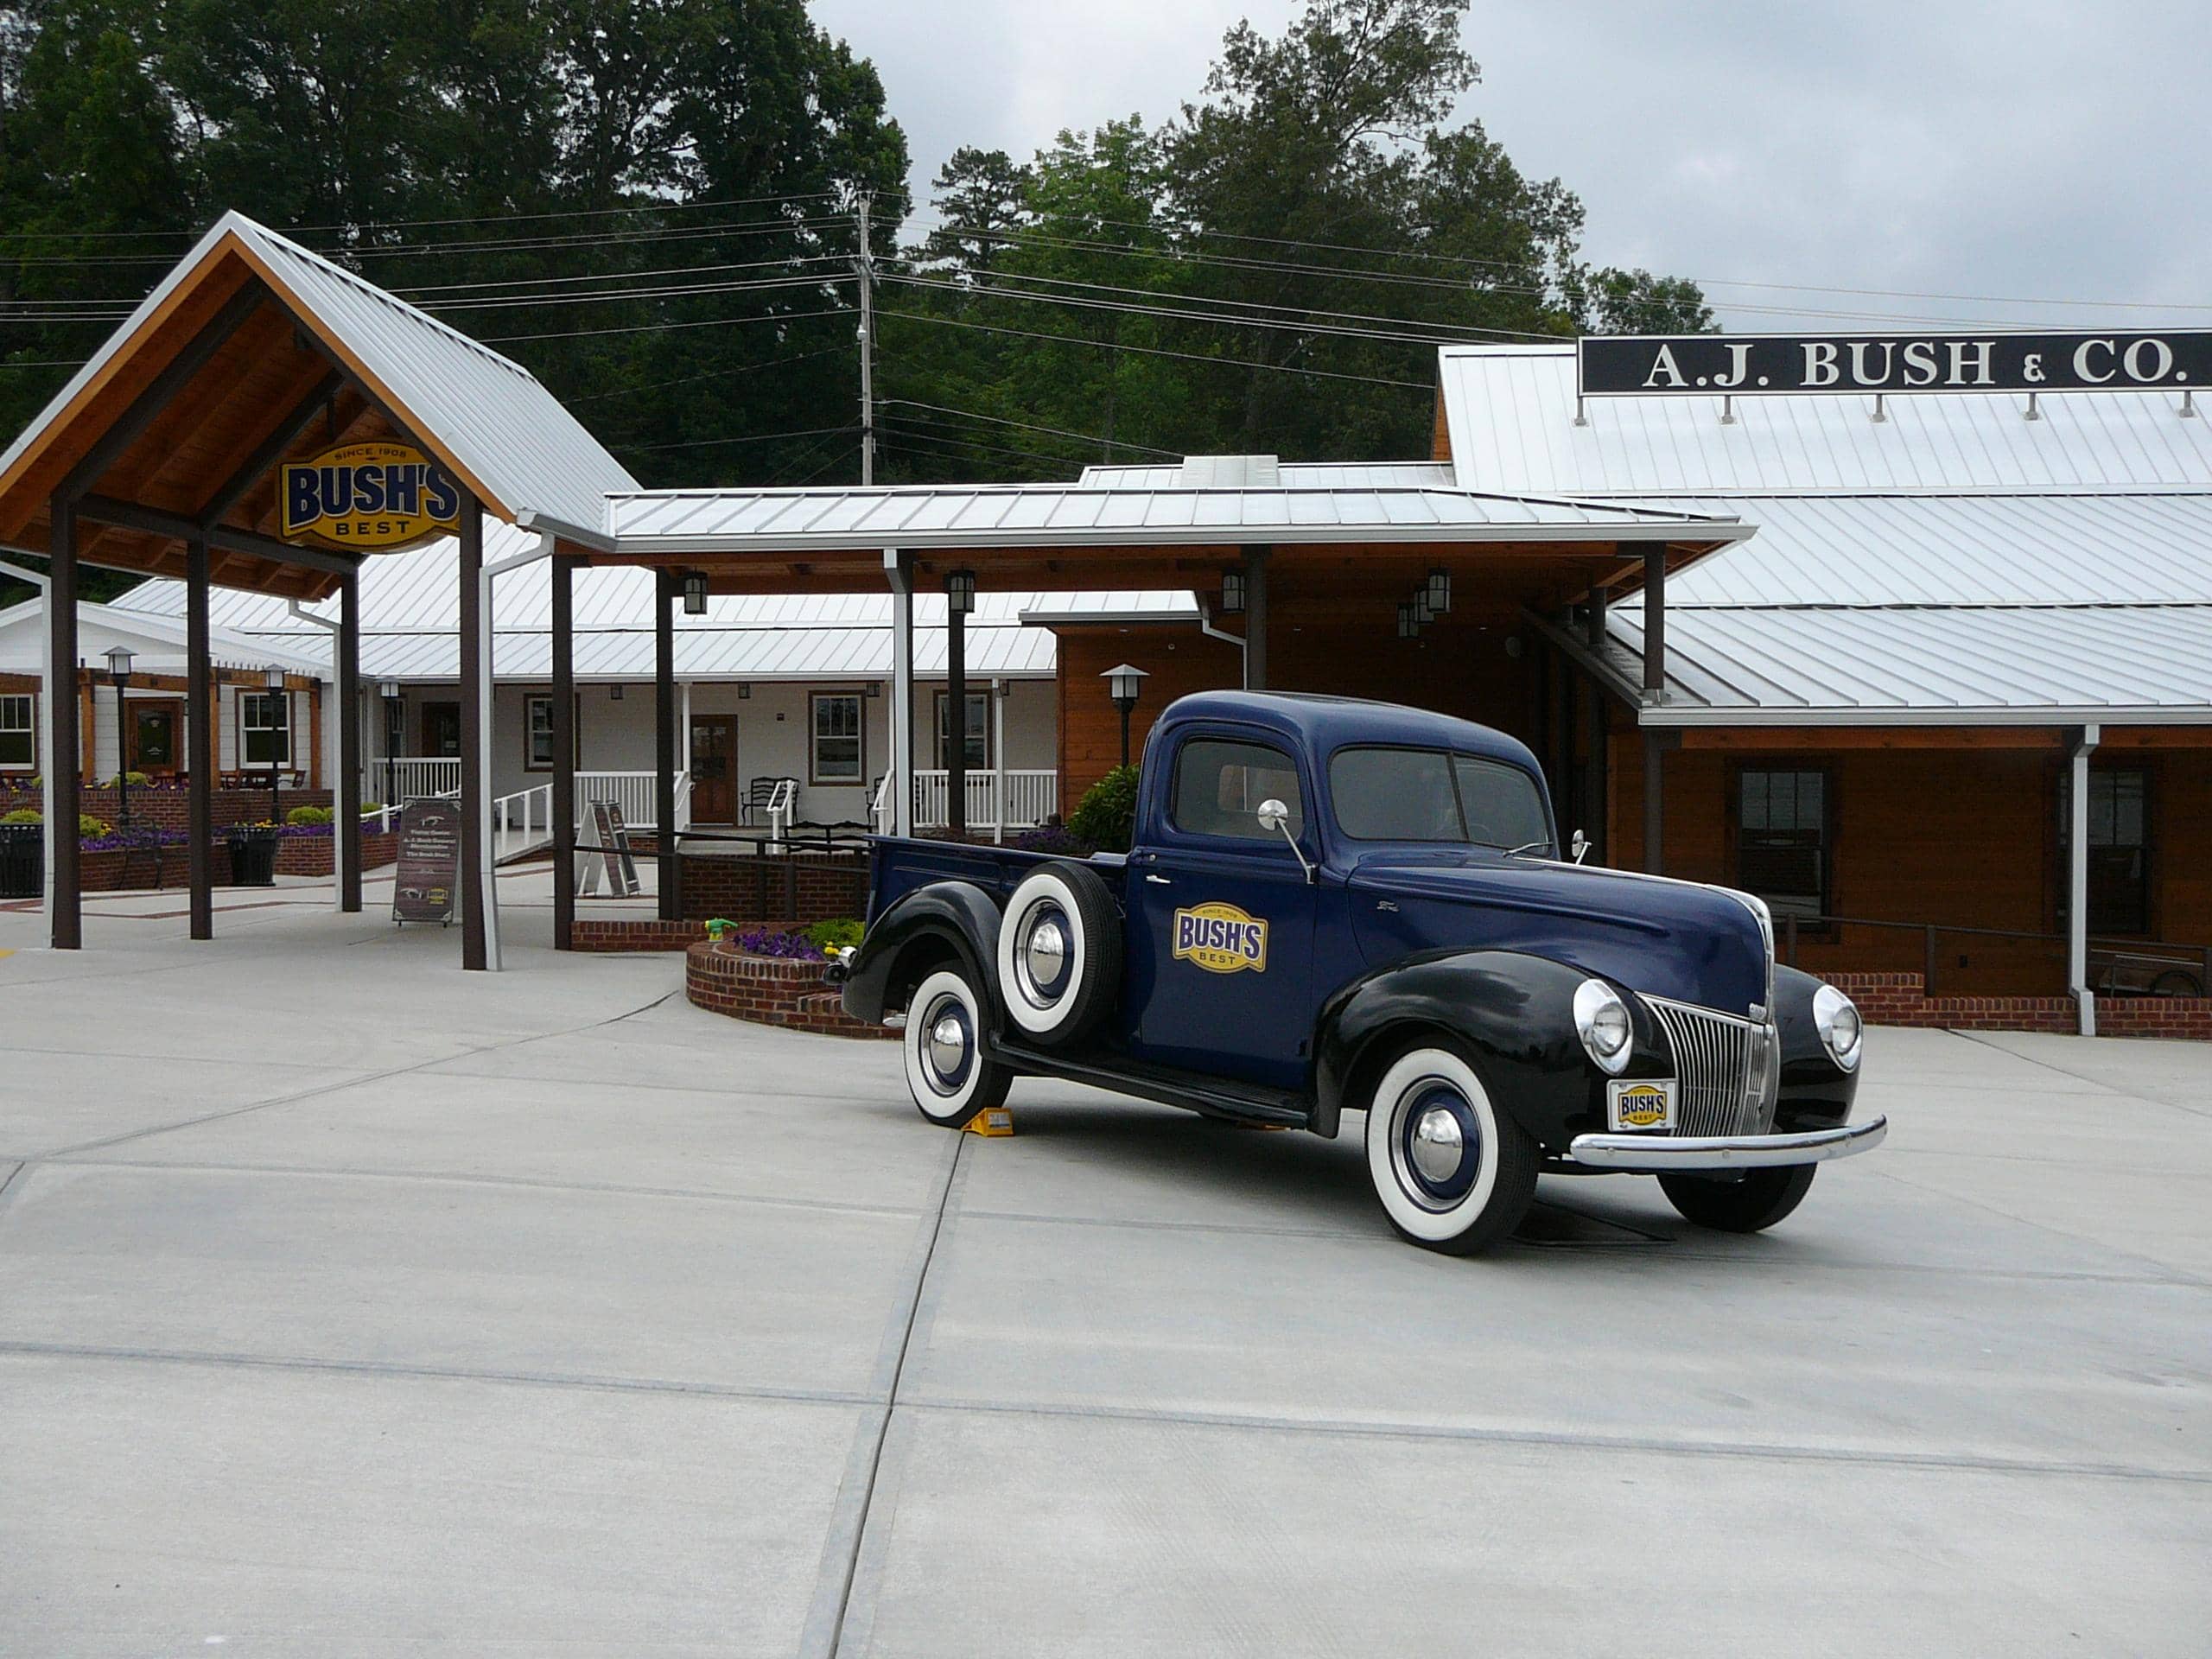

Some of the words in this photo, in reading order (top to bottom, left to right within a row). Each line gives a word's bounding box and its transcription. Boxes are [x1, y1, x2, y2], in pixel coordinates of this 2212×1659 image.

[1641, 343, 1770, 386] A.J.
[1799, 341, 1996, 386] BUSH
[2023, 353, 2046, 382] &
[2073, 338, 2188, 383] CO.
[334, 448, 374, 460] SINCE
[288, 465, 460, 529] BUSH'S
[335, 520, 410, 536] BEST
[1179, 916, 1262, 960] BUSH'S
[1199, 951, 1236, 965] BEST
[1621, 1094, 1664, 1116] BUSH'S
